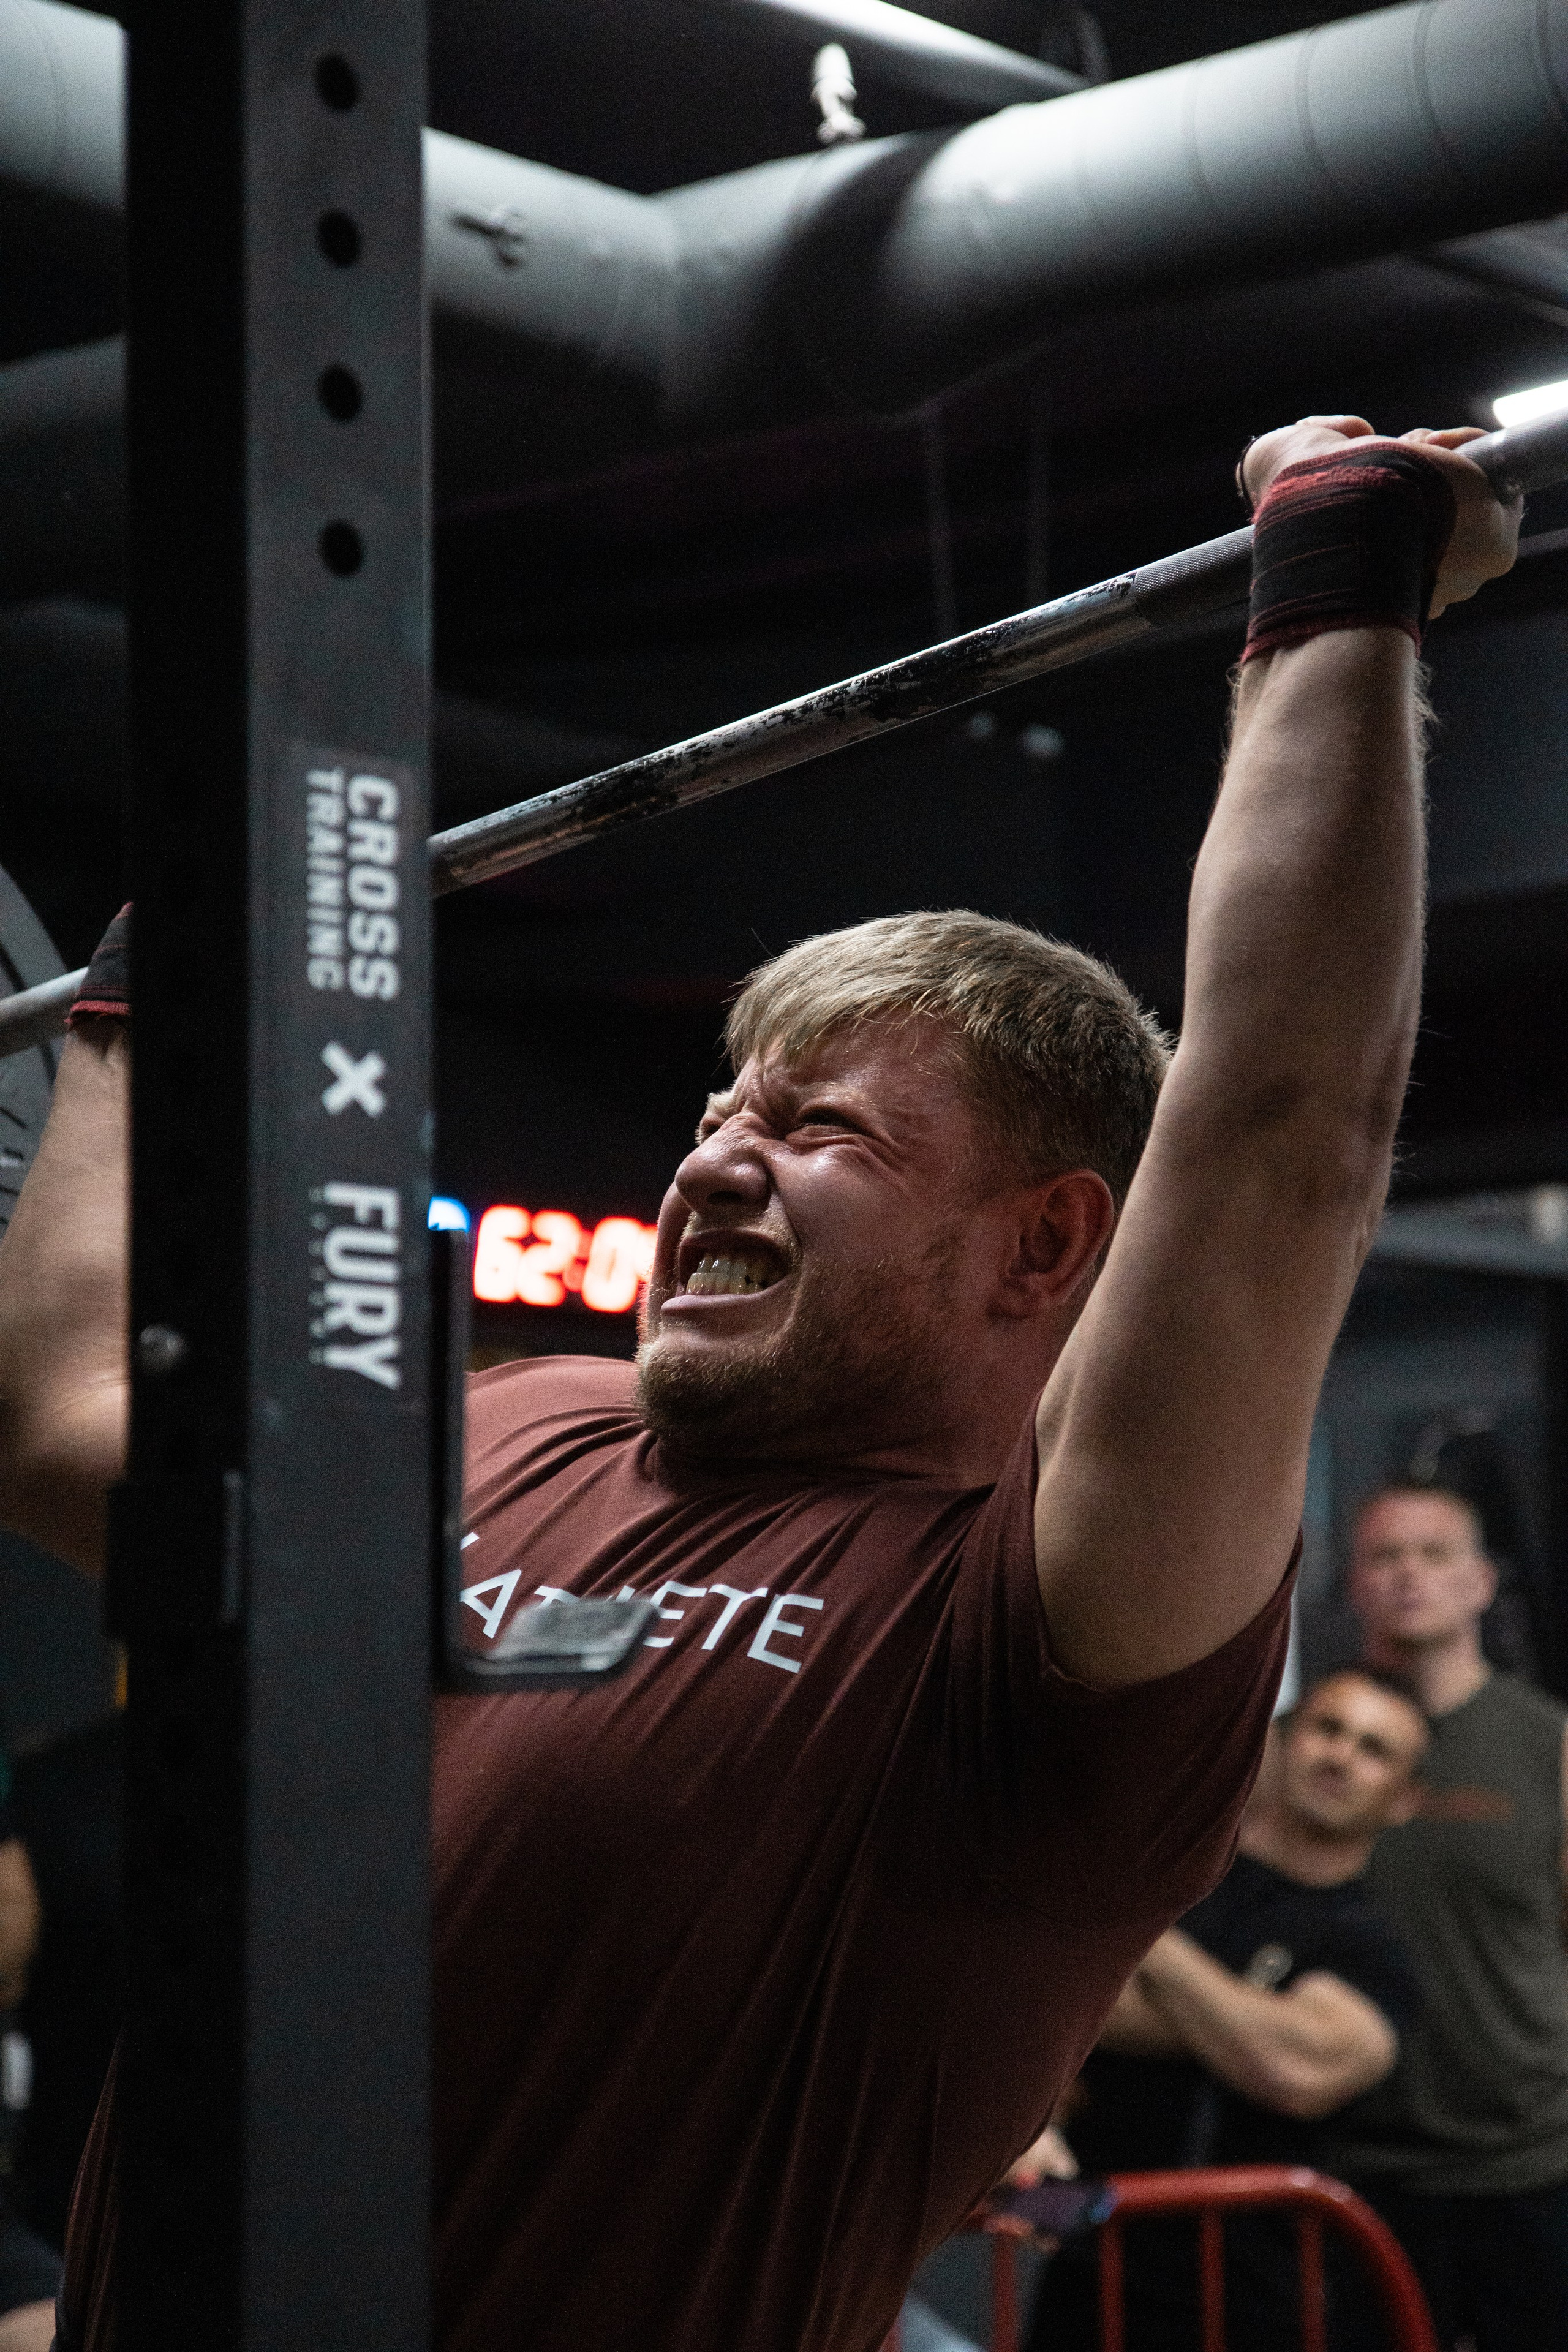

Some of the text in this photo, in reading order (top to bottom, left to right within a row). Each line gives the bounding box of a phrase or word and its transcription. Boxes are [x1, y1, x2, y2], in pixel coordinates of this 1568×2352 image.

[307, 766, 344, 990] TRAINING
[347, 775, 398, 1001] CROSS
[323, 1182, 400, 1390] FURY
[459, 1568, 824, 1673] ATETE
